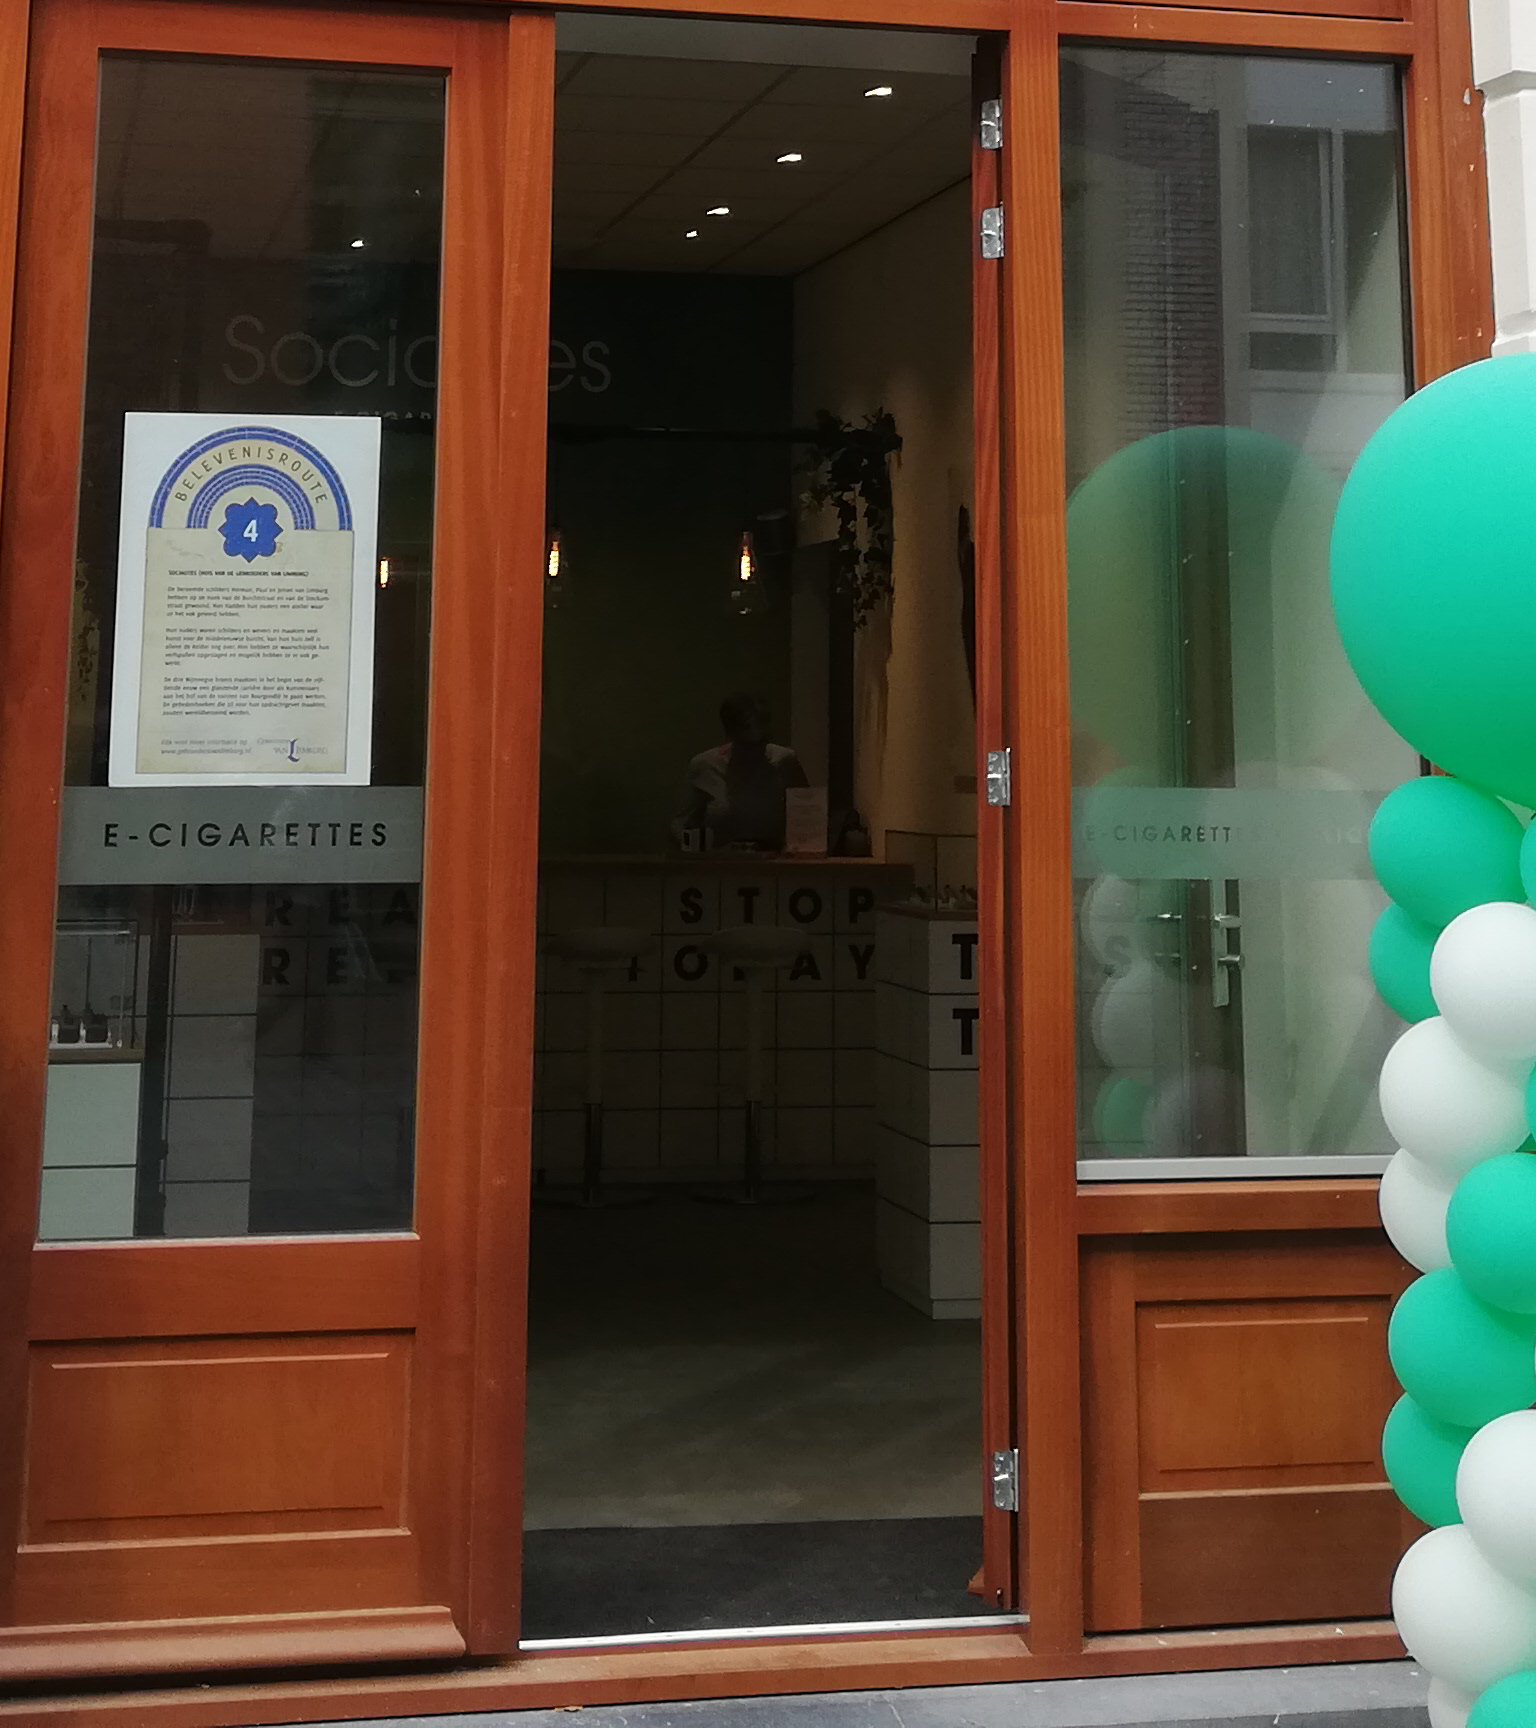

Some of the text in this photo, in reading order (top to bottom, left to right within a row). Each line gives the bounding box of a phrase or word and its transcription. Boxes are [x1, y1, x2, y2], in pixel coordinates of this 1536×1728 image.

[175, 446, 328, 504] BELEVENISROUTE
[243, 519, 260, 543] 4
[104, 822, 390, 848] E-CIGARETTES
[1086, 824, 1262, 844] E-CIGARETT
[679, 886, 875, 925] STOP
